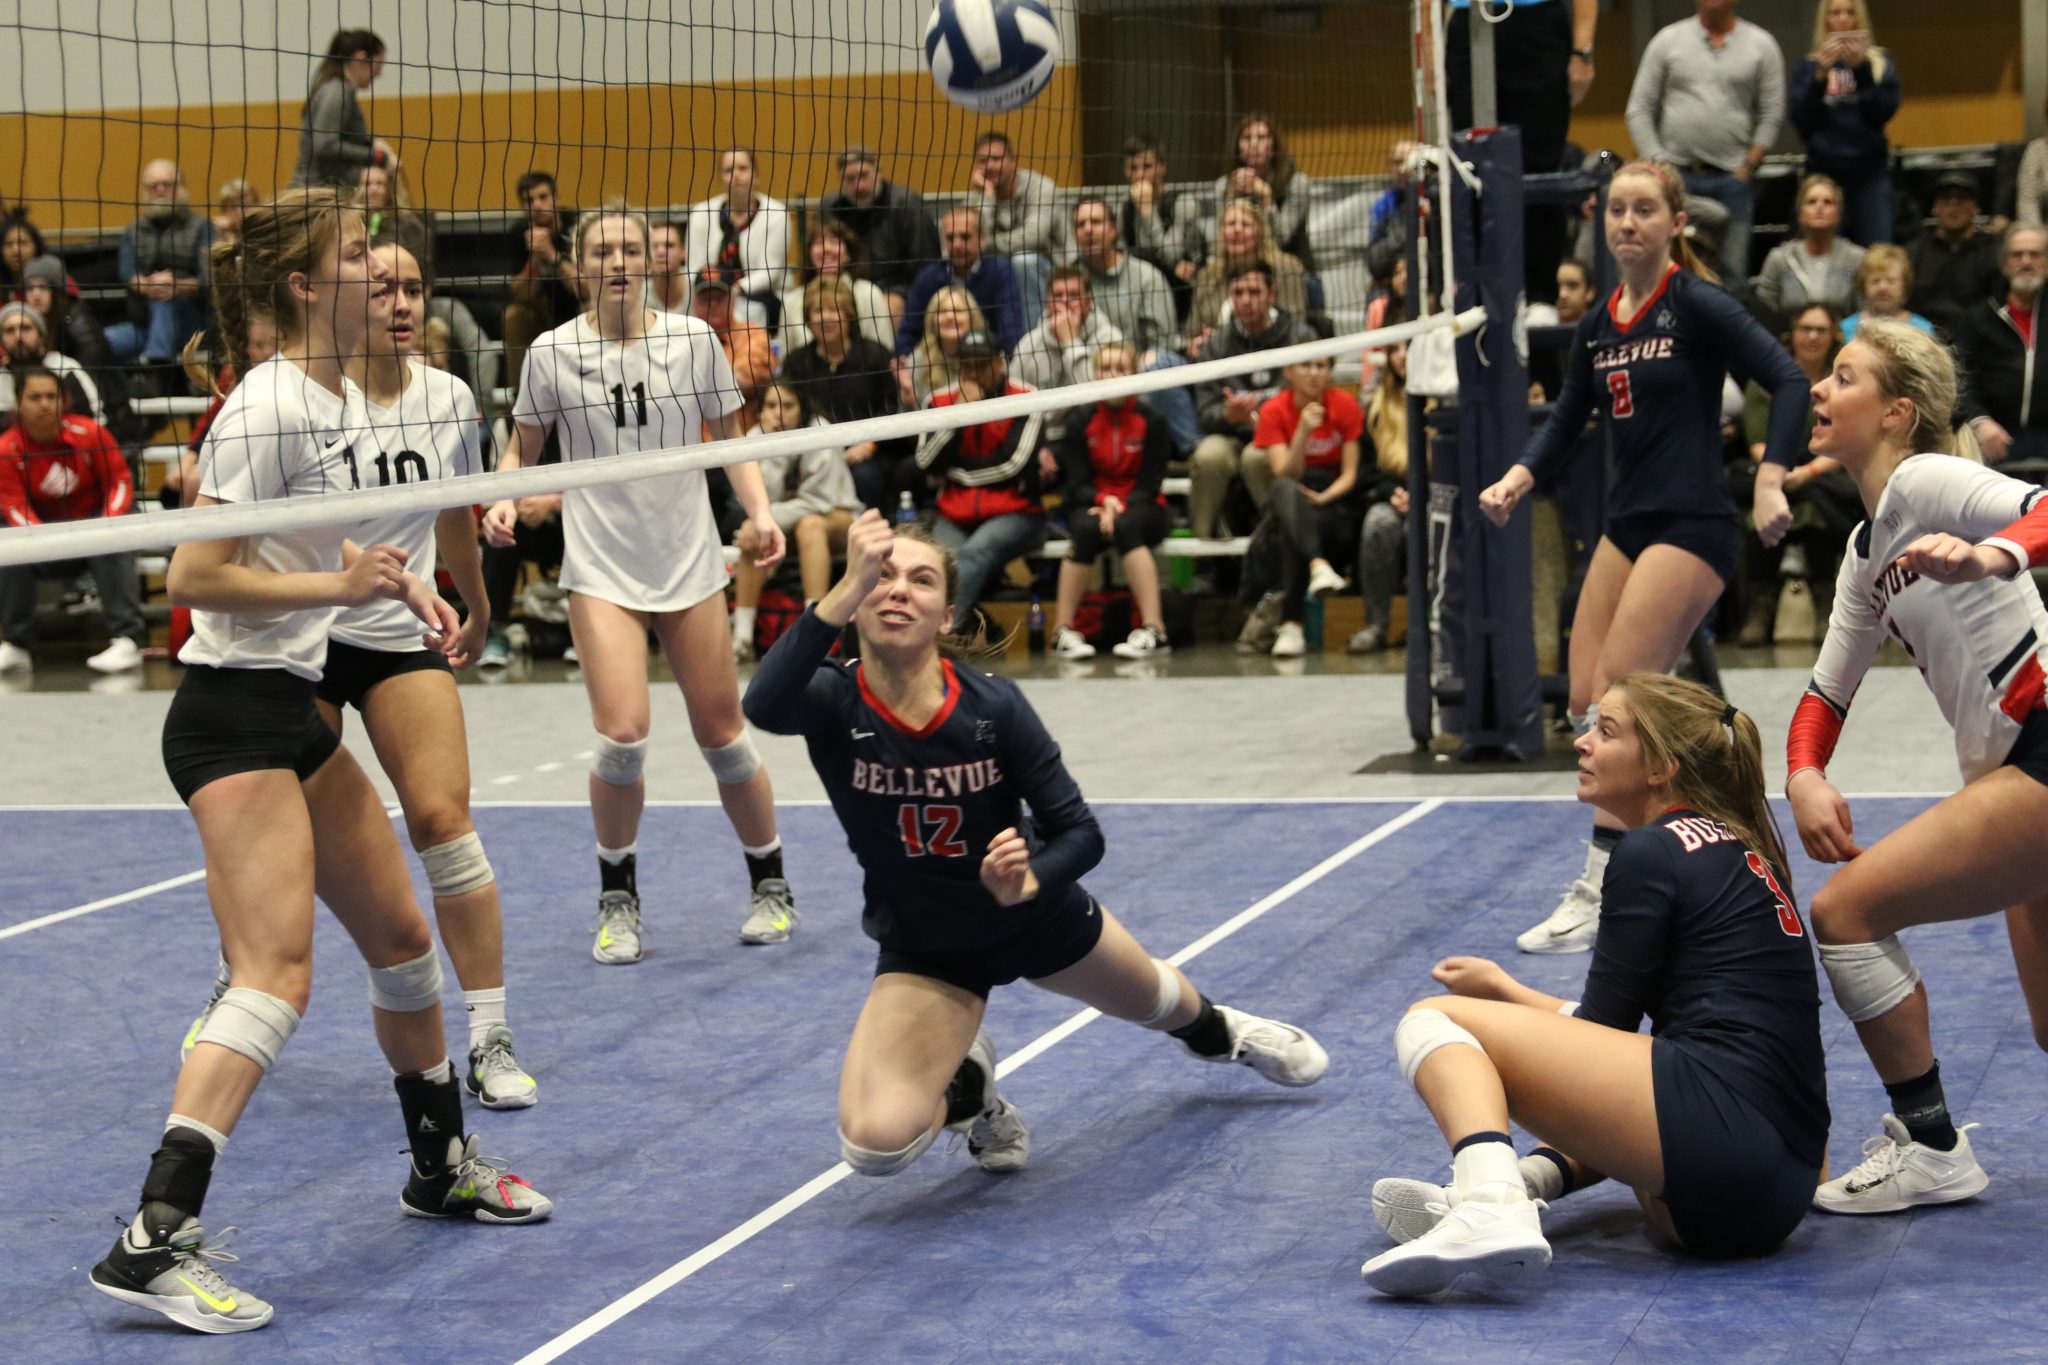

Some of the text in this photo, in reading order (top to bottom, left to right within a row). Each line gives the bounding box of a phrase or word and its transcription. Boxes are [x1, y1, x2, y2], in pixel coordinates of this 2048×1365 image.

[610, 381, 648, 428] 11
[1606, 369, 1634, 418] 8
[374, 450, 429, 487] 10
[850, 757, 1003, 798] BELLEVUE
[896, 803, 969, 858] 12
[1744, 850, 1804, 938] 3
